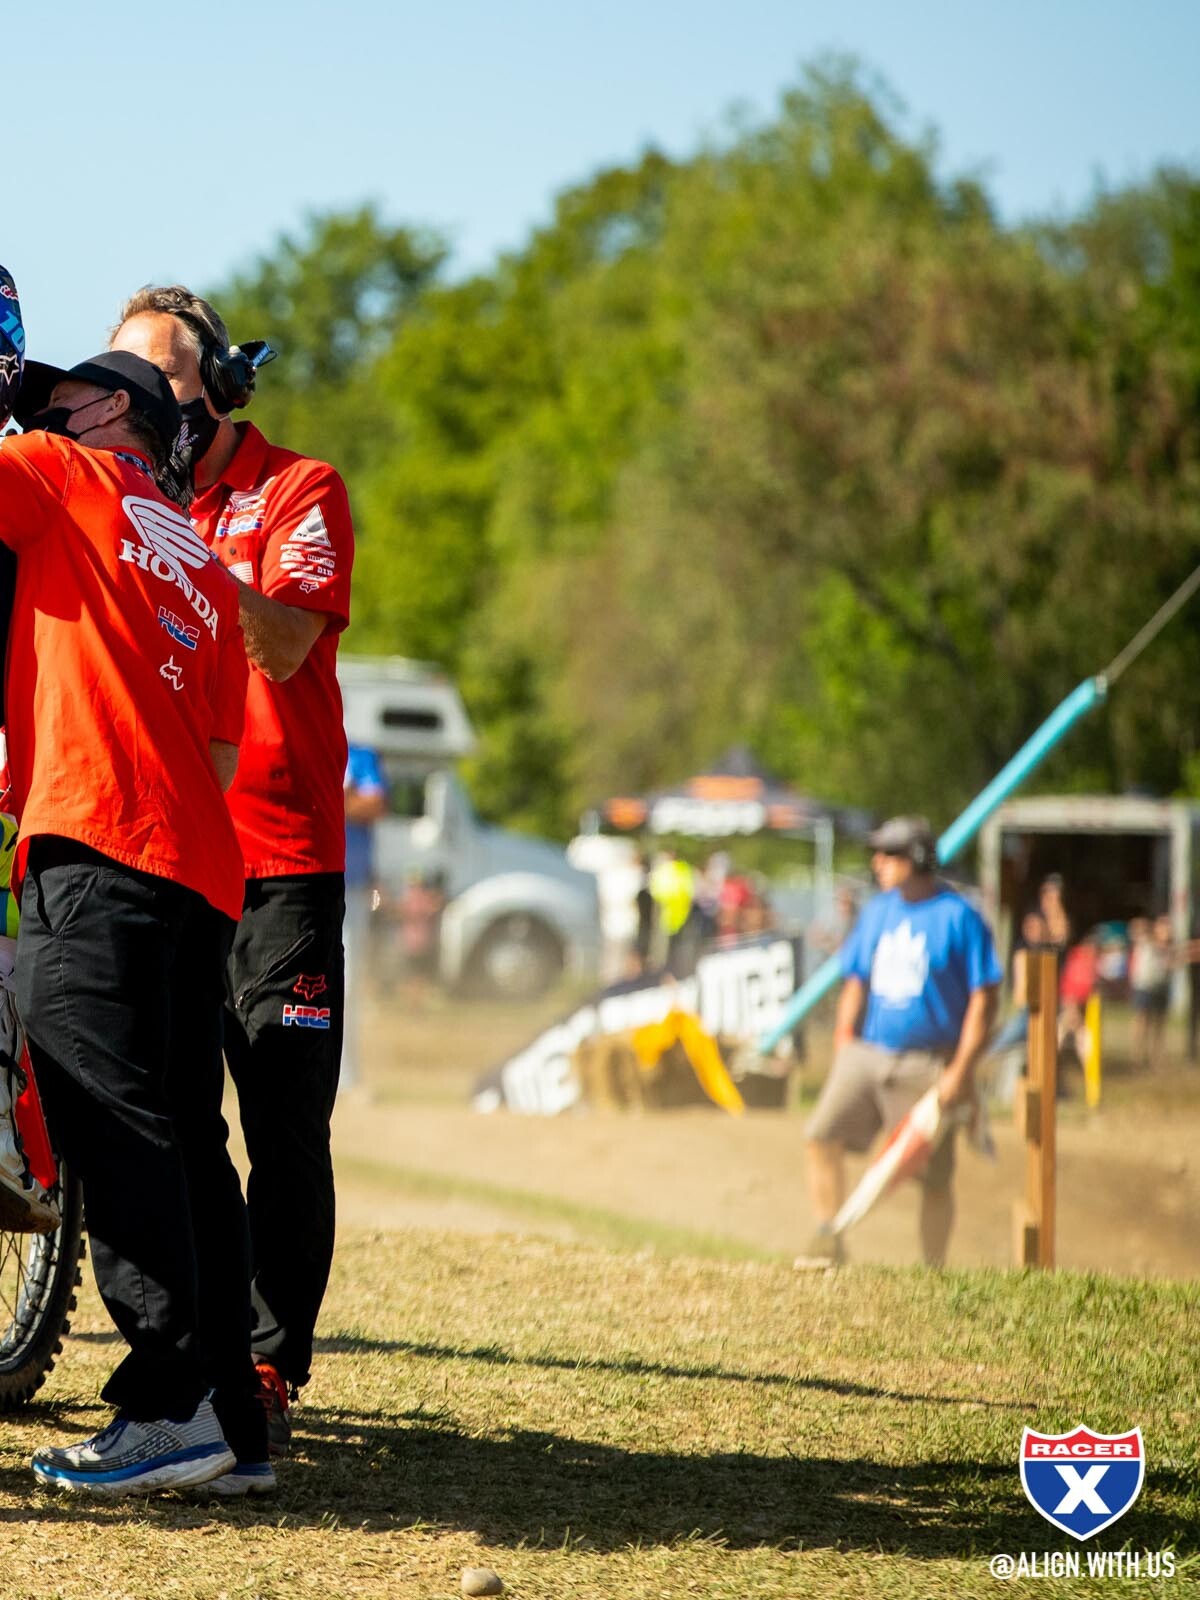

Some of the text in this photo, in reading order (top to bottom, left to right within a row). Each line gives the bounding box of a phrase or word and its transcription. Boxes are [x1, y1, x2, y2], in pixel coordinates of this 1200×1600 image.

[119, 538, 219, 641] HONDA
[157, 605, 200, 651] HRC
[283, 1004, 330, 1029] HRC
